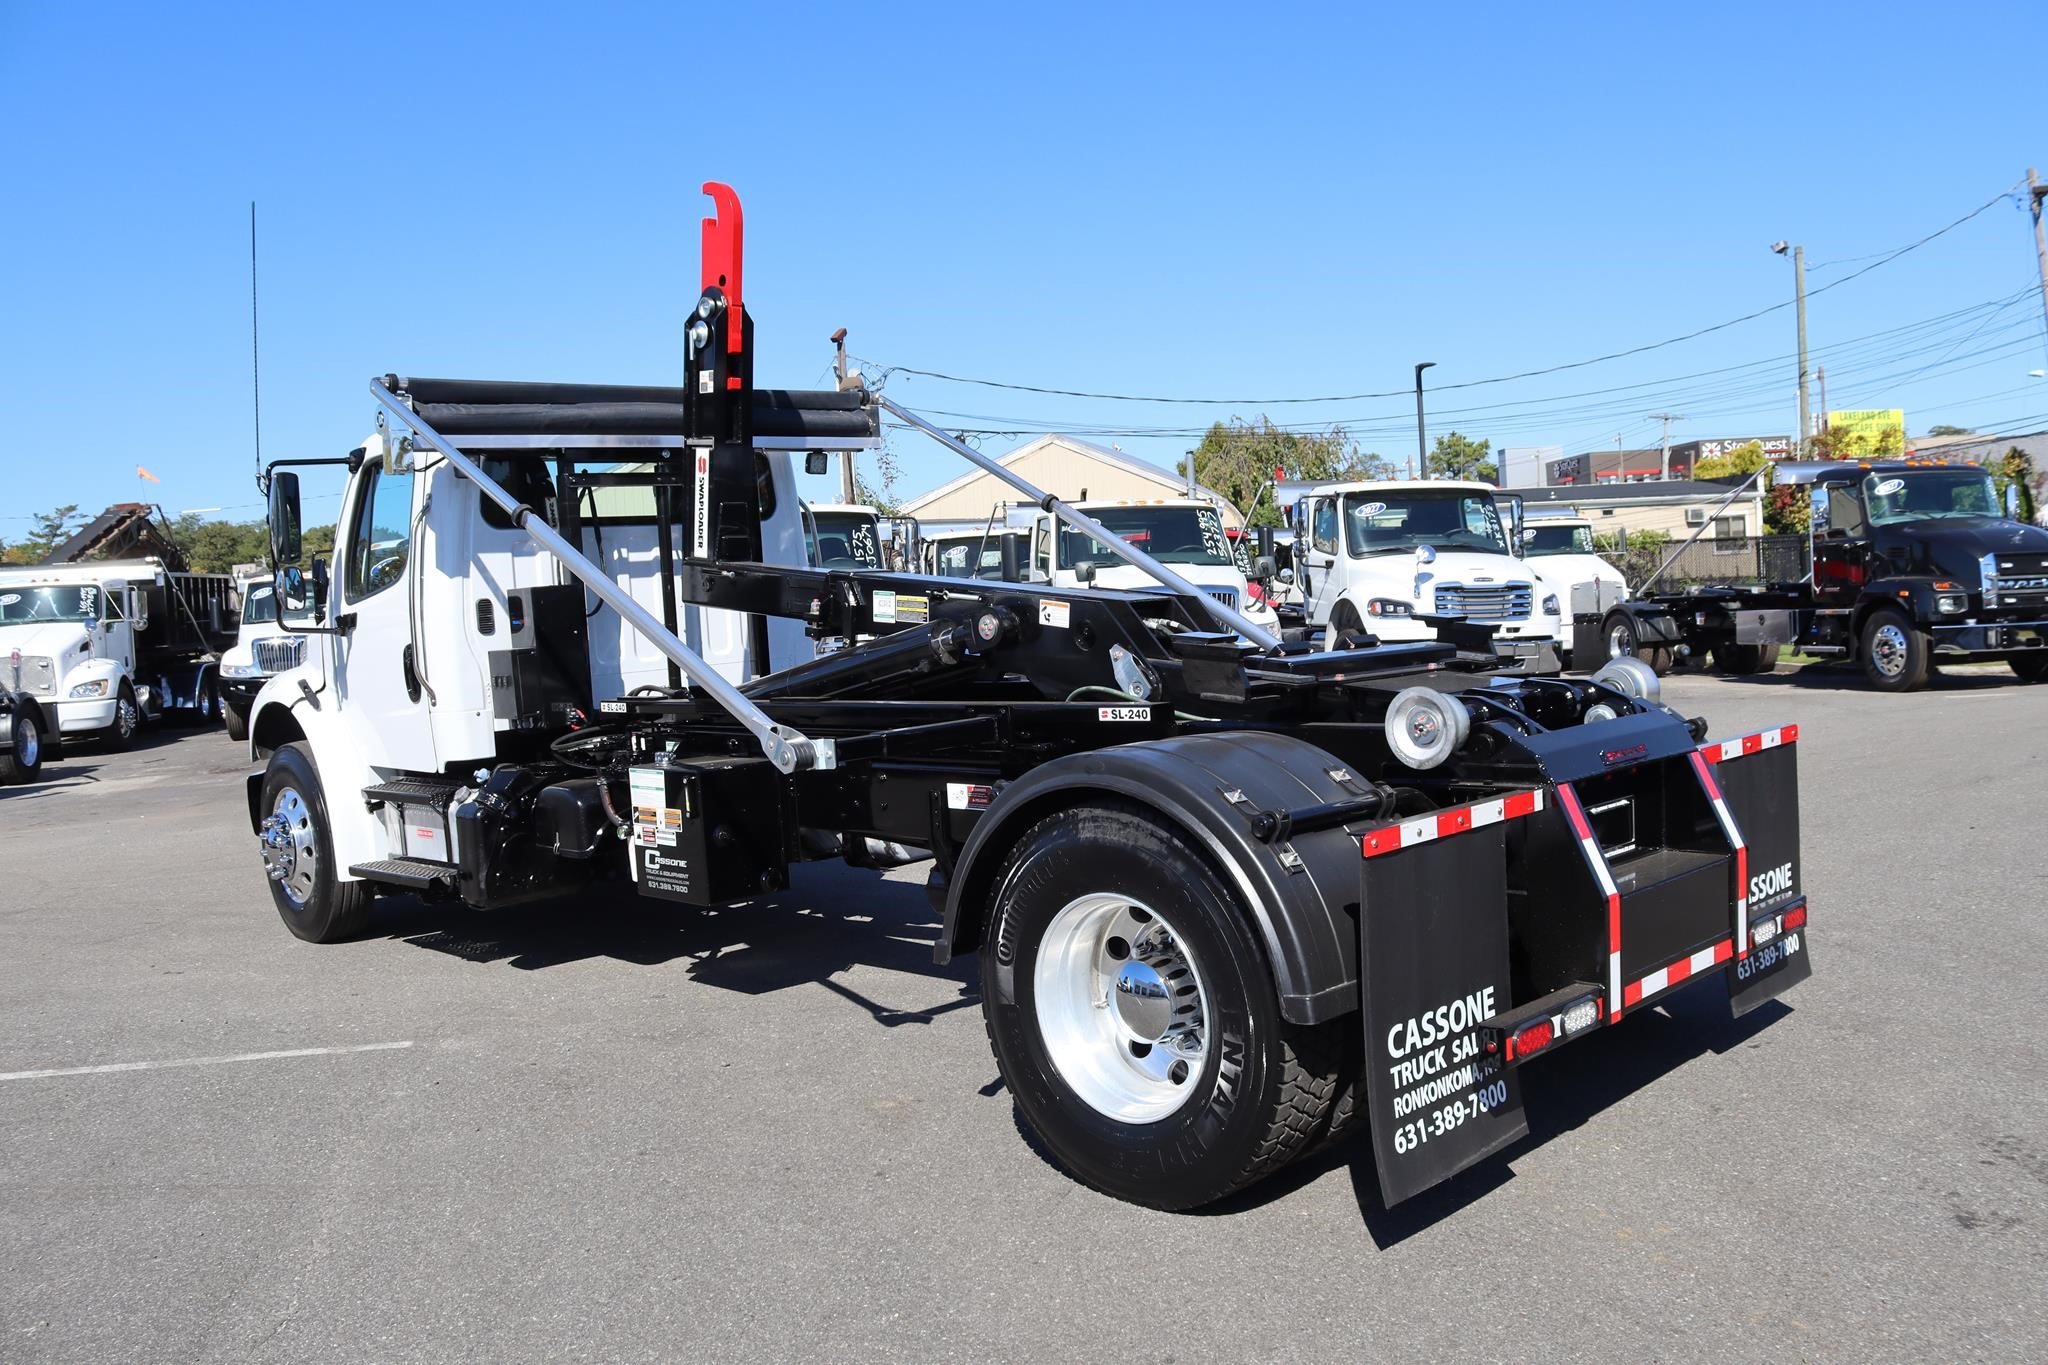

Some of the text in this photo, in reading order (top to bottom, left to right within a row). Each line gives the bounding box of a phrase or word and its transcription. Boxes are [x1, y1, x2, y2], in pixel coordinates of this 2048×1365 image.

[698, 476, 706, 550] SWAPLOADER
[1998, 579, 2048, 590] MAC
[607, 703, 626, 712] SL-240
[1111, 708, 1148, 720] SL-240
[1737, 933, 1800, 980] 631-389-7800
[1387, 985, 1496, 1059] CASSONE
[1390, 1045, 1448, 1090] TRUCK
[1394, 1079, 1507, 1155] 631-389-7800
